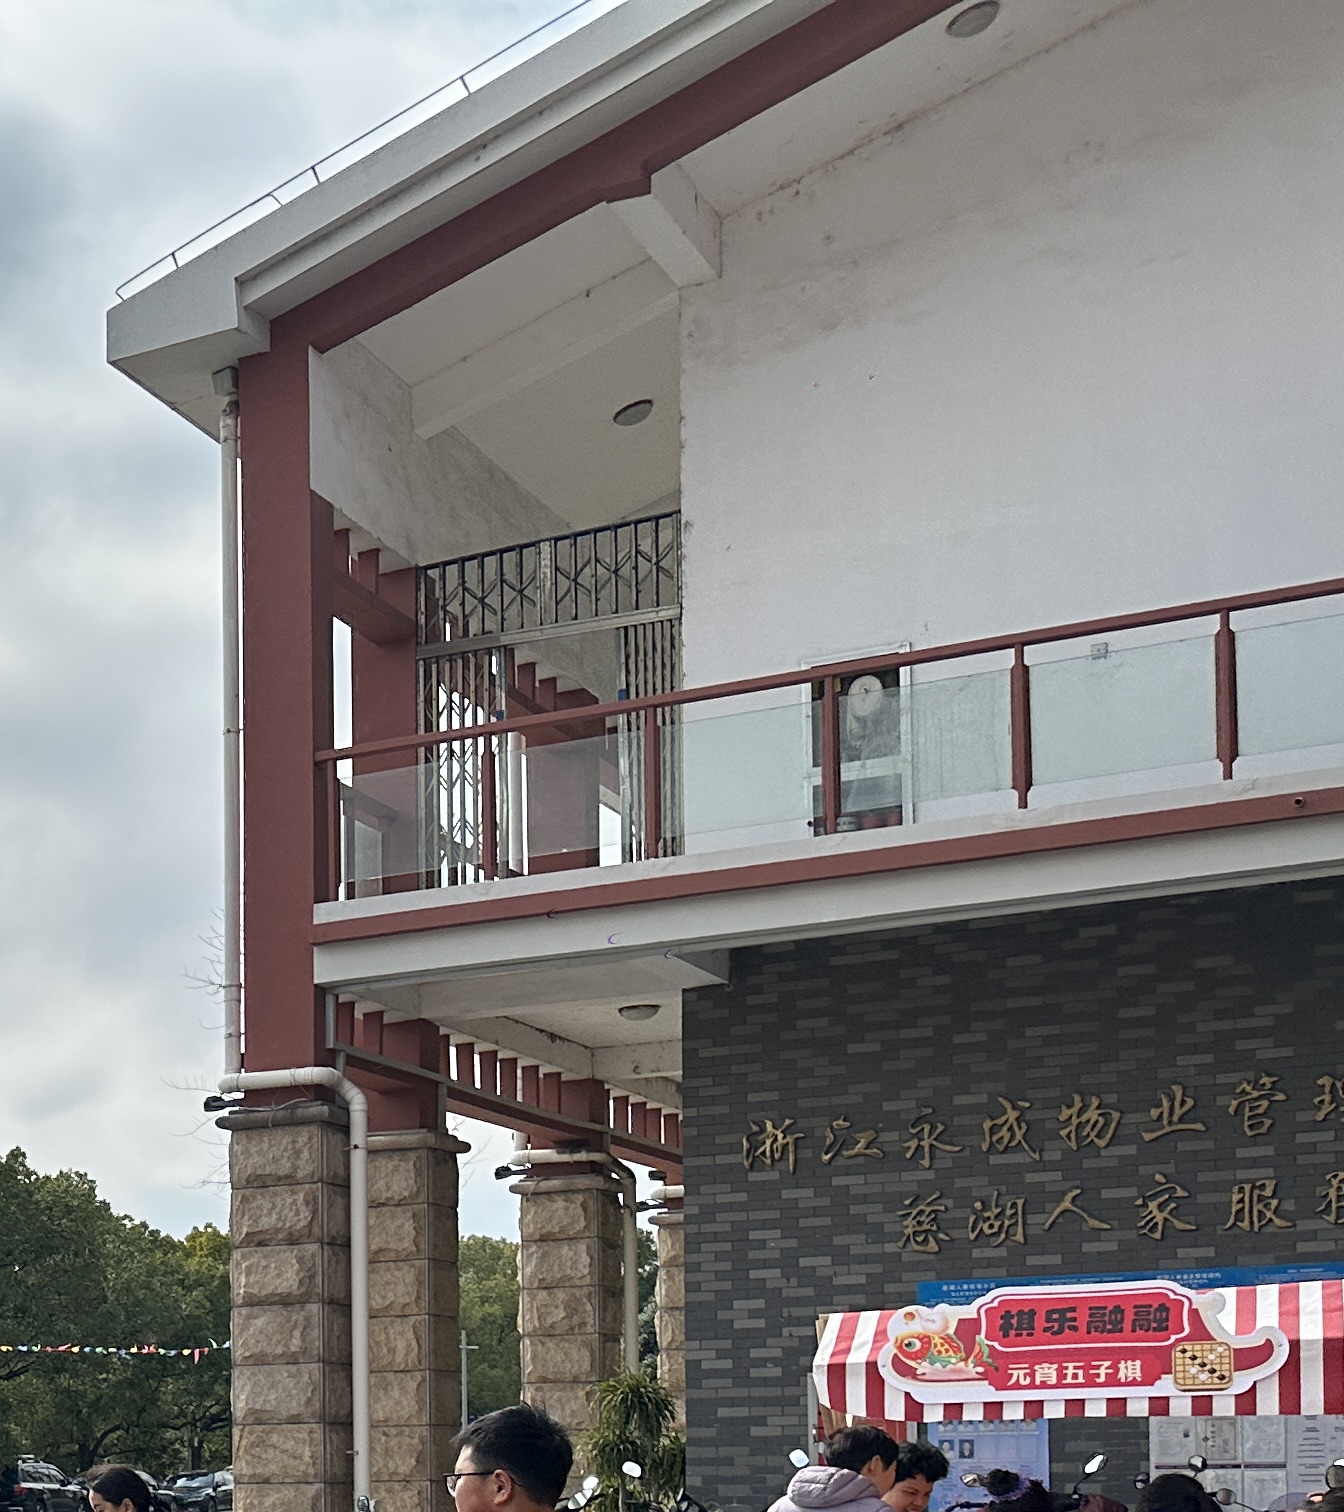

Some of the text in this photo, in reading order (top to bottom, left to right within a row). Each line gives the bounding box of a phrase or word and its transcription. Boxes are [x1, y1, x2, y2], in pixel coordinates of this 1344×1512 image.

[999, 1303, 1171, 1339] 棋乐融融
[1006, 1359, 1143, 1386] 元宵五子棋
